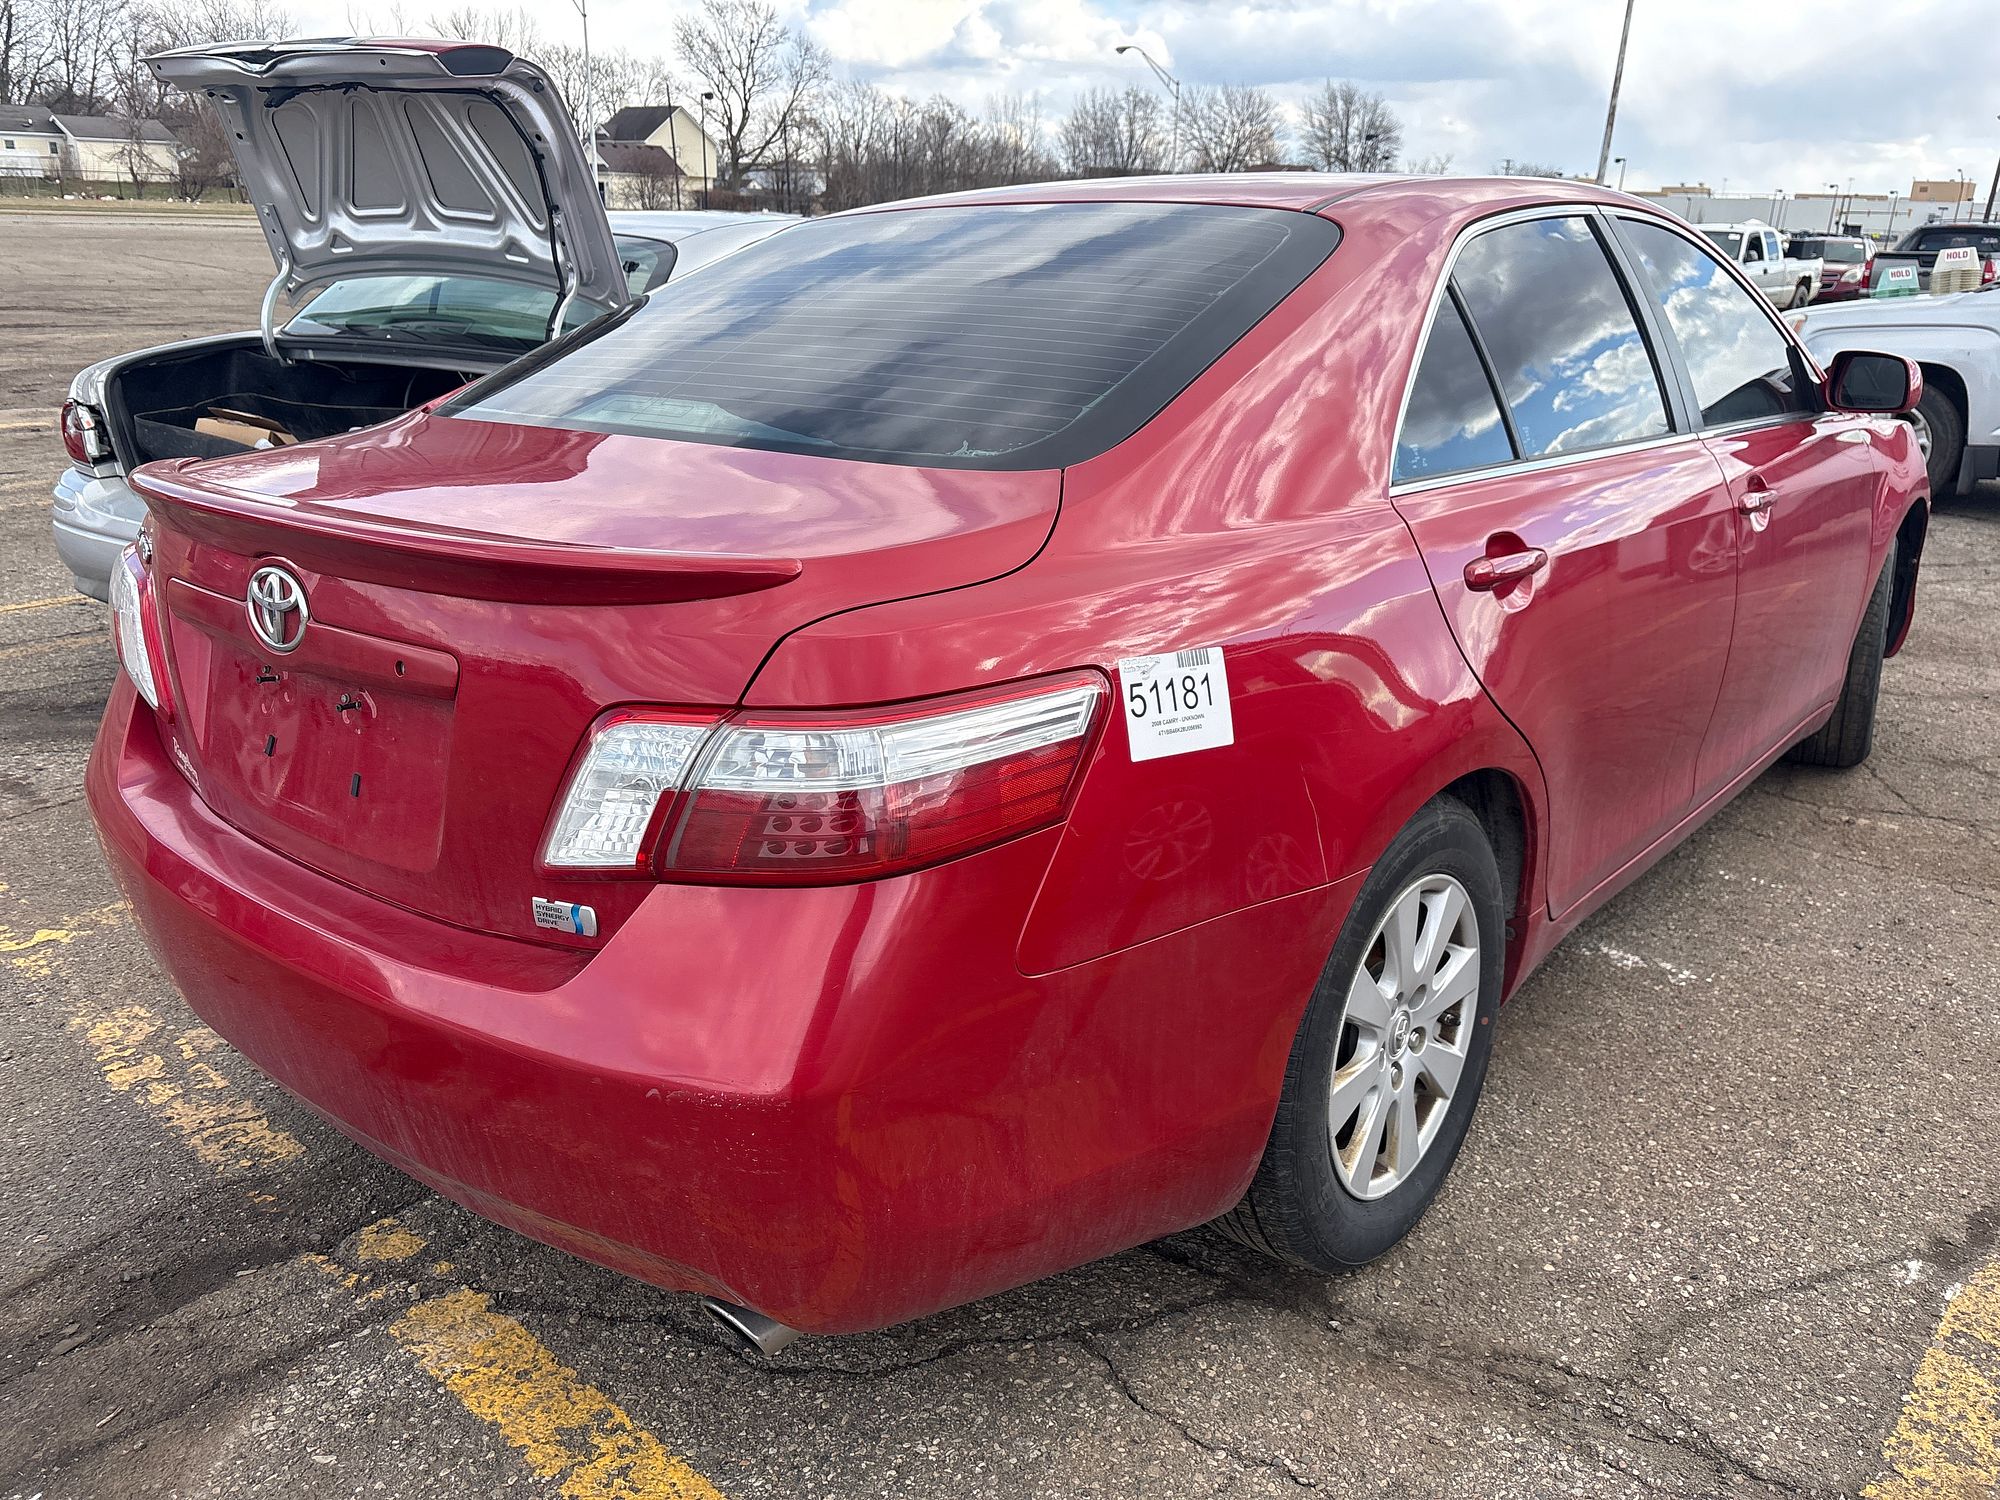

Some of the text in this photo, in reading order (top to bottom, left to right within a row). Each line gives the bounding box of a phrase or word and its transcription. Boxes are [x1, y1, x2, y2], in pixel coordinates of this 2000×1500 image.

[1946, 250, 1969, 260] HOLD
[1890, 269, 1911, 278] HOLD
[1129, 672, 1212, 718] 51181
[1162, 717, 1179, 726] CAMRY
[1181, 713, 1205, 722] UNKNOWN
[535, 903, 563, 914] HYBRID
[536, 910, 570, 922] SYNERGY
[537, 916, 560, 927] DRIVE
